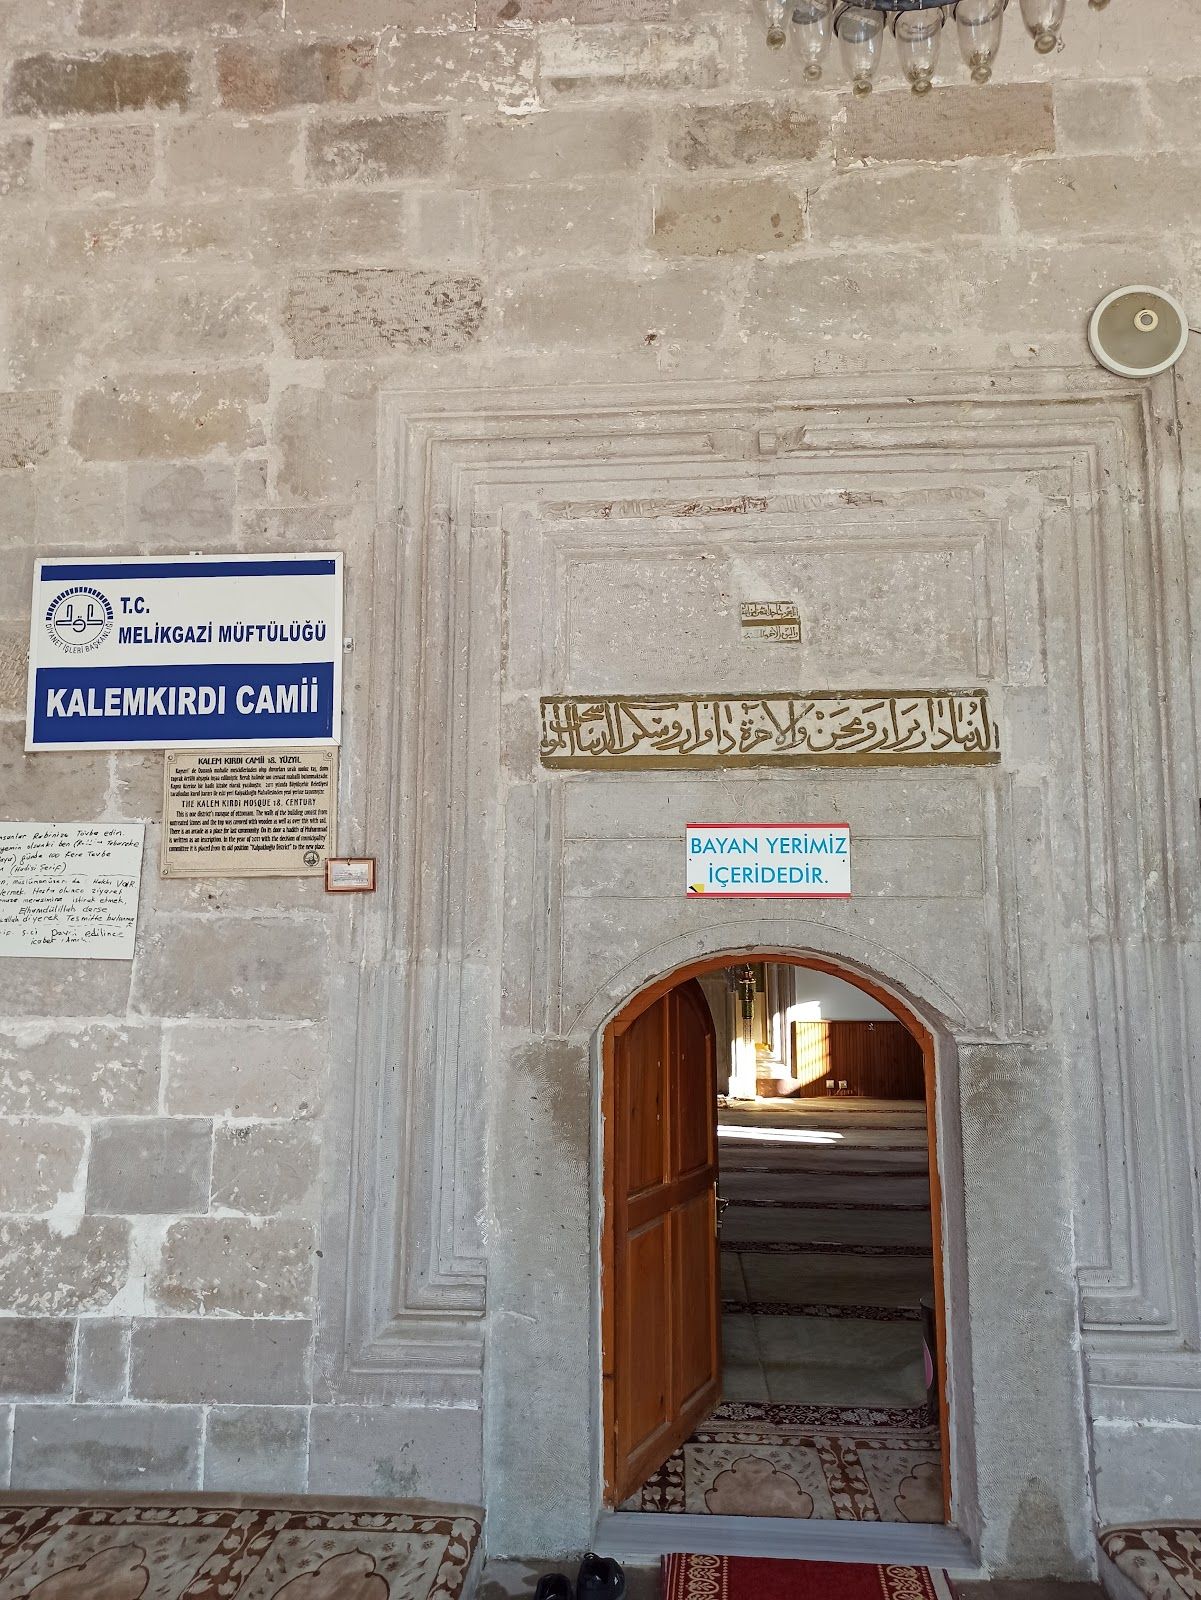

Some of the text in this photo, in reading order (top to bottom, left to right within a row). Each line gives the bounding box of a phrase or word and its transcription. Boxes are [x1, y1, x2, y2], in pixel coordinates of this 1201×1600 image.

[120, 597, 150, 614] T.C.
[118, 620, 326, 644] MELİKGAZİ MÜFTÜLÜĞÜ
[46, 677, 319, 718] KALEMKIRDI CAMİİ
[224, 757, 243, 765] KIRDI
[182, 800, 195, 808] THE
[197, 799, 220, 808] KALEM
[244, 799, 271, 808] MOSQUE
[286, 798, 316, 807] CENTURY
[691, 833, 847, 854] BAYAN YERİMİZ
[709, 863, 828, 887] İÇERİDEDİR.
